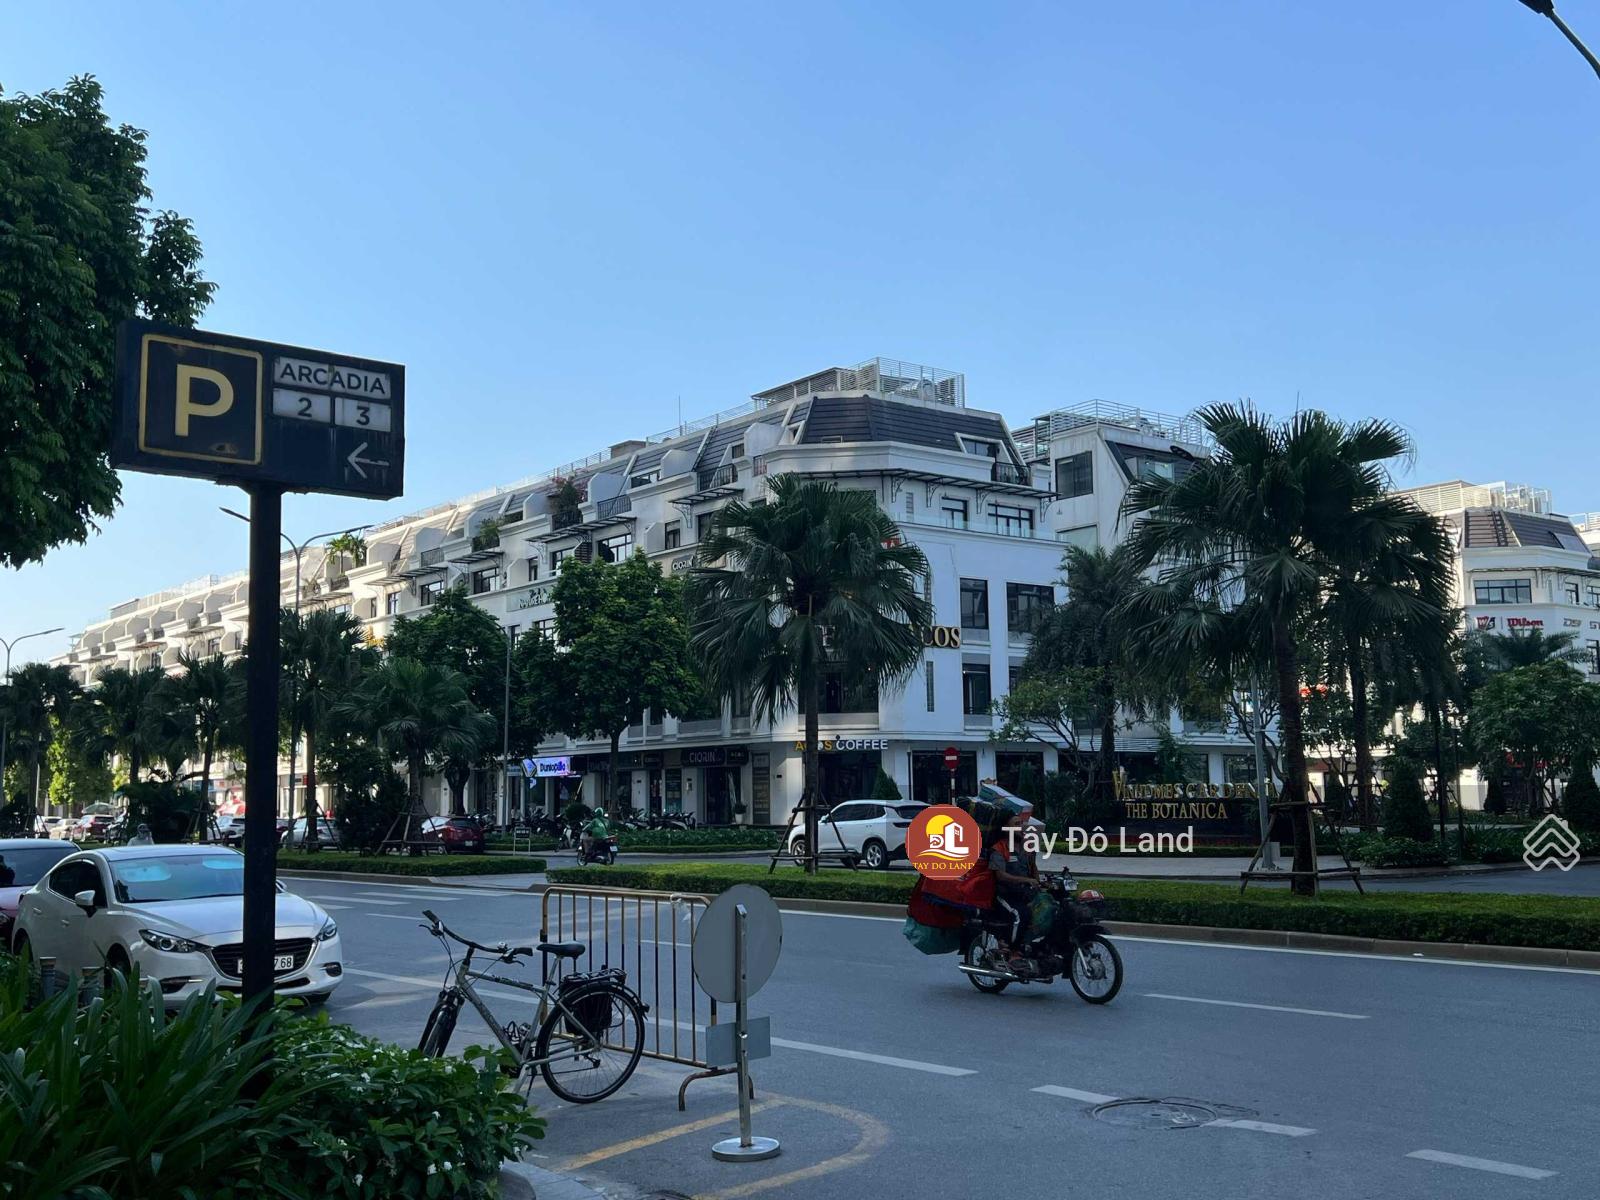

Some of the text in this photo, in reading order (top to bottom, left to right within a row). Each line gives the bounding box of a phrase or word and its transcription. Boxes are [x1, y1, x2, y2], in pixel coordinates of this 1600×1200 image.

[280, 363, 386, 394] ARCADIA
[174, 363, 235, 437] P
[297, 397, 371, 426] 2 3
[1507, 618, 1544, 628] Wilson
[910, 625, 960, 648] COS
[836, 739, 889, 750] COFFEE
[689, 751, 716, 763] CIORIN
[1126, 803, 1229, 819] THE BOTANICA
